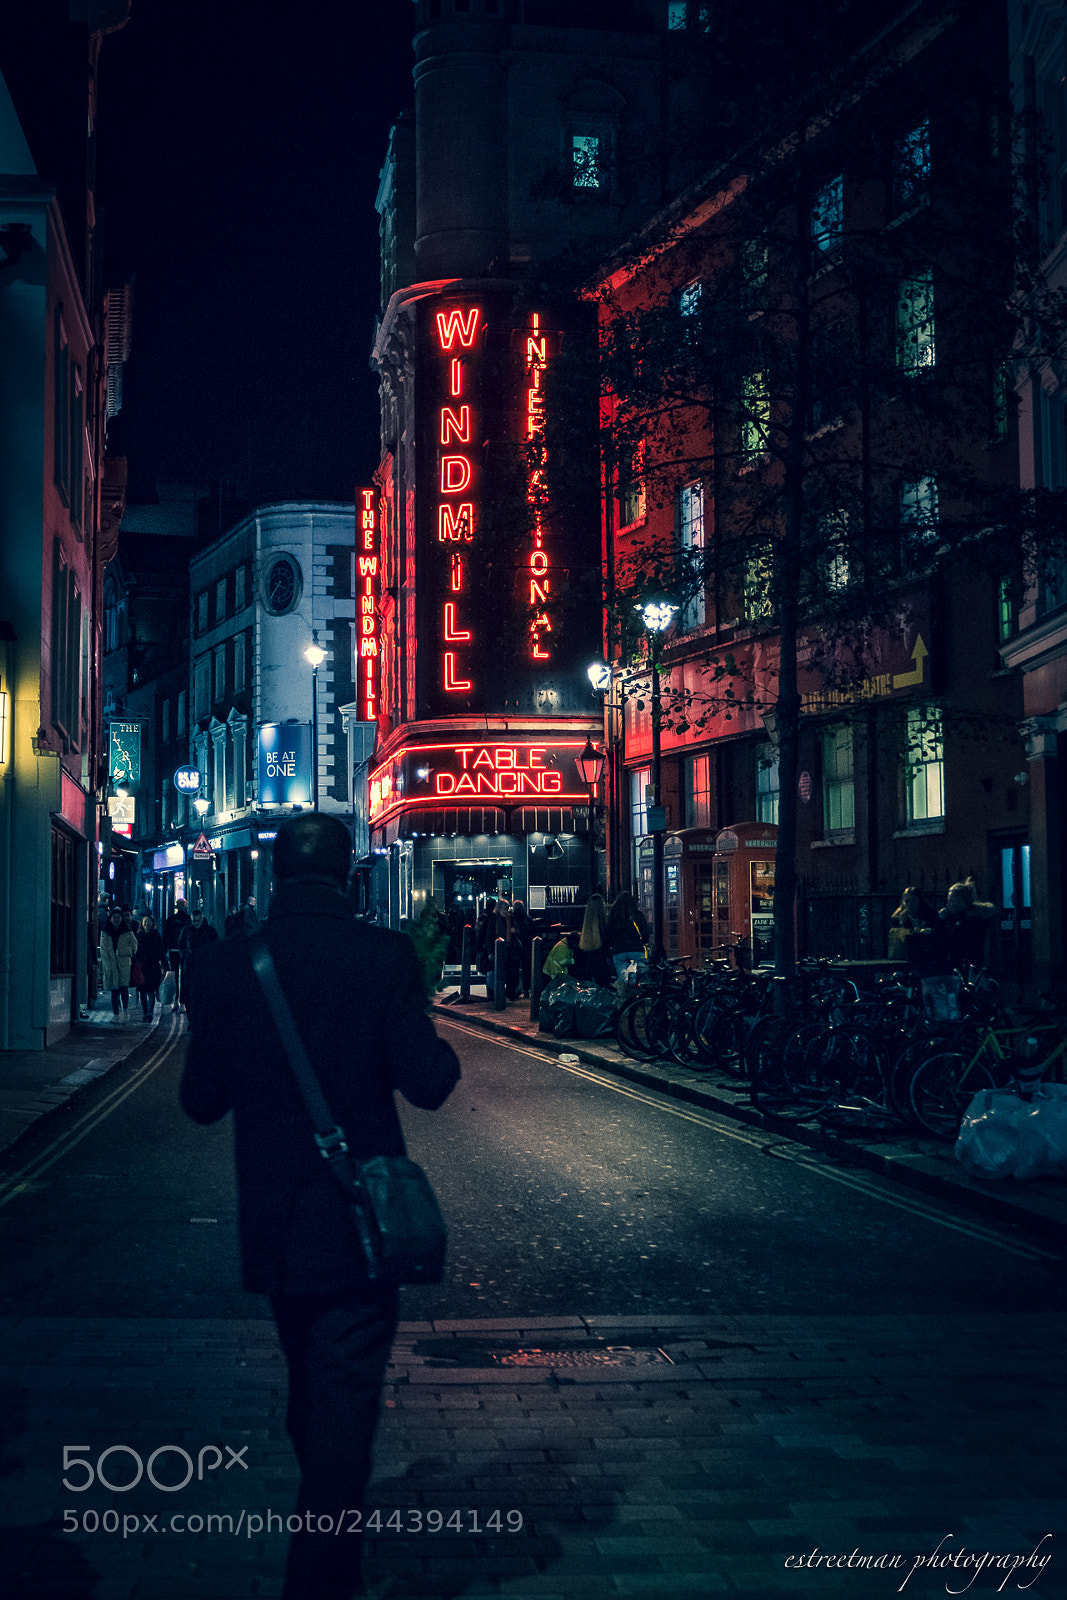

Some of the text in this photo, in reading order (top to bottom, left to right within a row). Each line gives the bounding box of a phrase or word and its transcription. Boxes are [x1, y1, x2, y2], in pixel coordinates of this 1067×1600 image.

[437, 308, 478, 690] WINDMILL
[359, 490, 377, 719] THE WINDMILL
[119, 724, 139, 733] THE
[266, 751, 296, 764] BE AT
[454, 748, 547, 770] TABLE
[266, 763, 296, 777] ONE
[436, 772, 561, 794] DANCING
